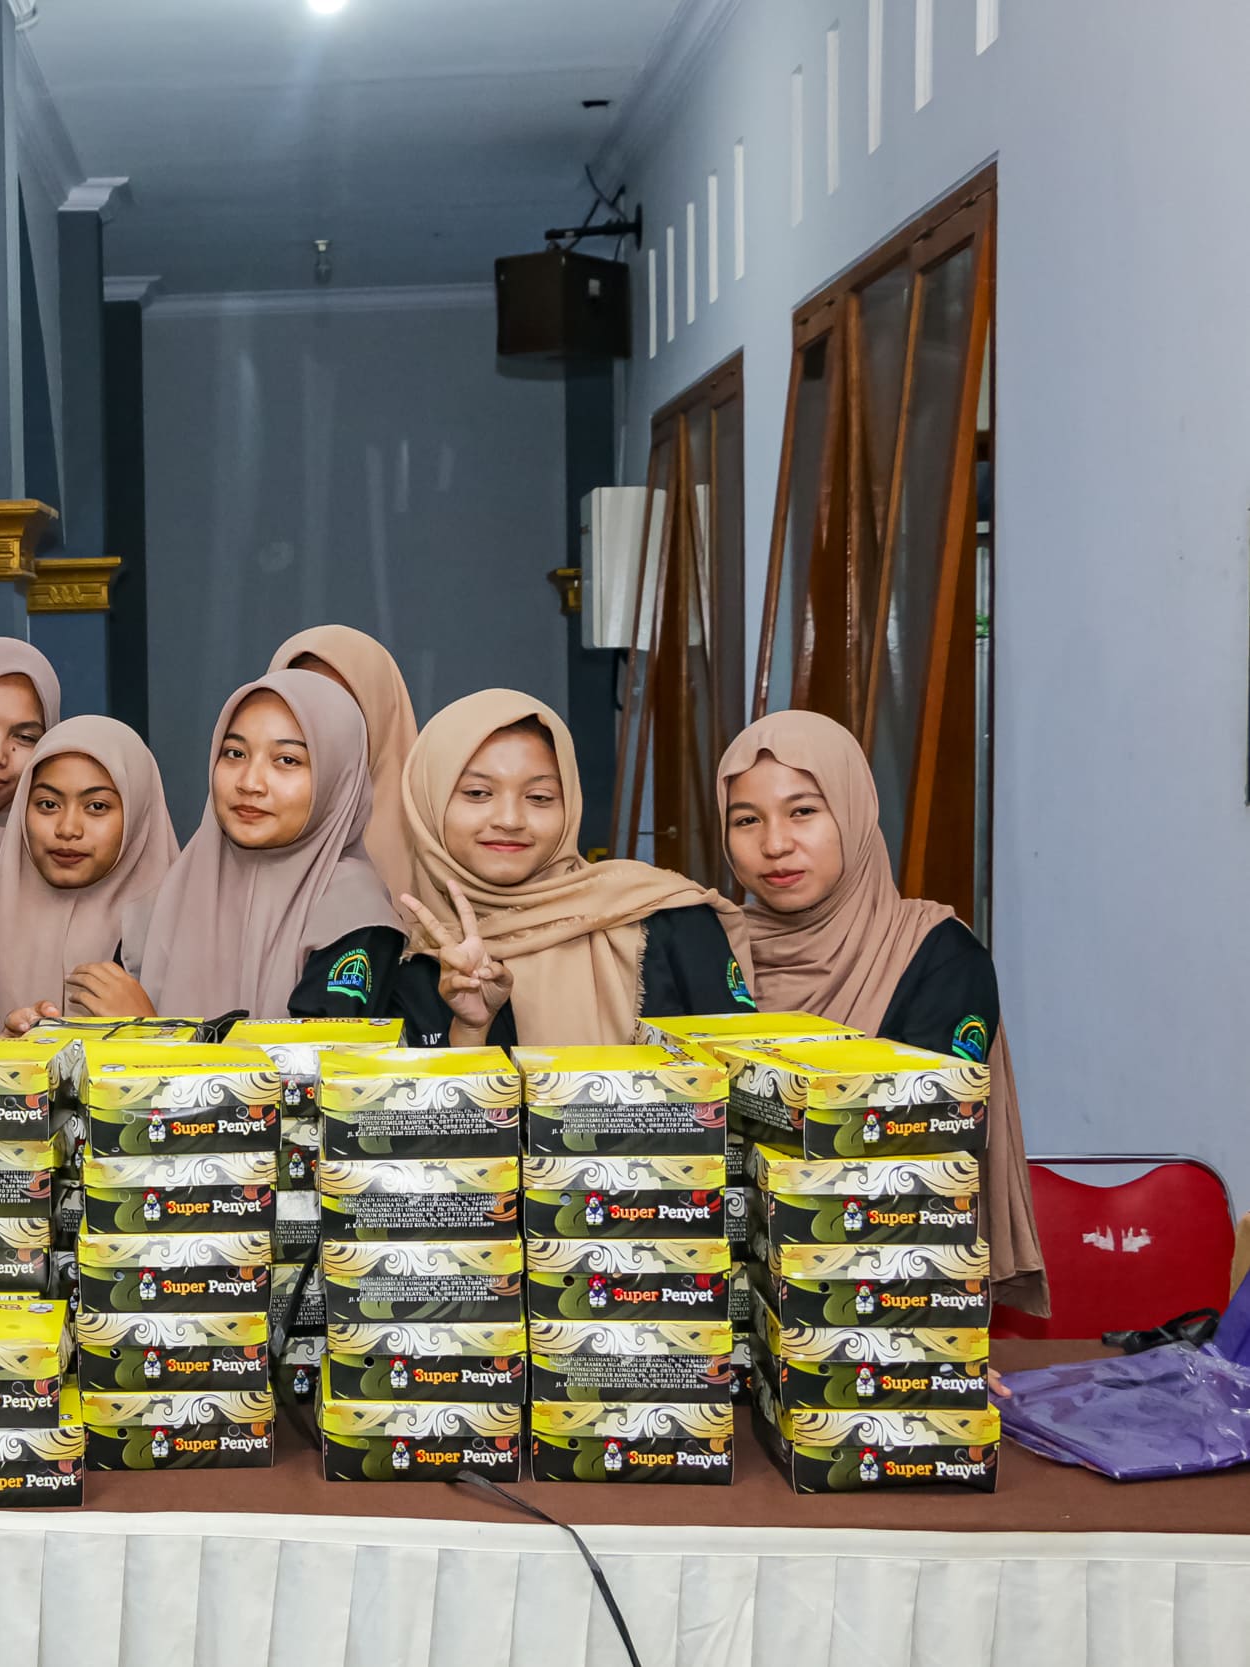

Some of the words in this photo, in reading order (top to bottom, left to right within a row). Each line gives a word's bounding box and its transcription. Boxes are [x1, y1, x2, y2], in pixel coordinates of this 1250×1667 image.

[171, 1122, 216, 1136] Super
[218, 1120, 266, 1136] Penyet
[886, 1121, 927, 1136] Super
[929, 1117, 975, 1134] Penyet
[166, 1200, 210, 1216] Super
[212, 1200, 262, 1216] Penyet
[608, 1205, 655, 1221] Super
[658, 1205, 710, 1221] Penyet
[868, 1210, 916, 1226] Super
[919, 1211, 972, 1228] Penyet
[162, 1280, 206, 1296] Super
[208, 1280, 258, 1296] Penyet
[612, 1287, 659, 1303] Super
[661, 1288, 714, 1304] Penyet
[880, 1293, 928, 1309] Super
[930, 1293, 984, 1310] Penyet
[166, 1358, 210, 1374] Super
[212, 1358, 262, 1374] Penyet
[413, 1369, 458, 1384] Super
[461, 1369, 512, 1386] Penyet
[881, 1376, 928, 1392] Super
[931, 1376, 985, 1393] Penyet
[2, 1394, 52, 1411] Penyet
[174, 1438, 217, 1454] Super
[220, 1436, 268, 1453] Penyet
[415, 1450, 460, 1465] Super
[463, 1450, 513, 1466] Penyet
[627, 1450, 674, 1467] Super
[676, 1451, 729, 1469] Penyet
[884, 1462, 932, 1478] Super
[935, 1461, 986, 1479] Penyet
[26, 1474, 76, 1490] Penyet
